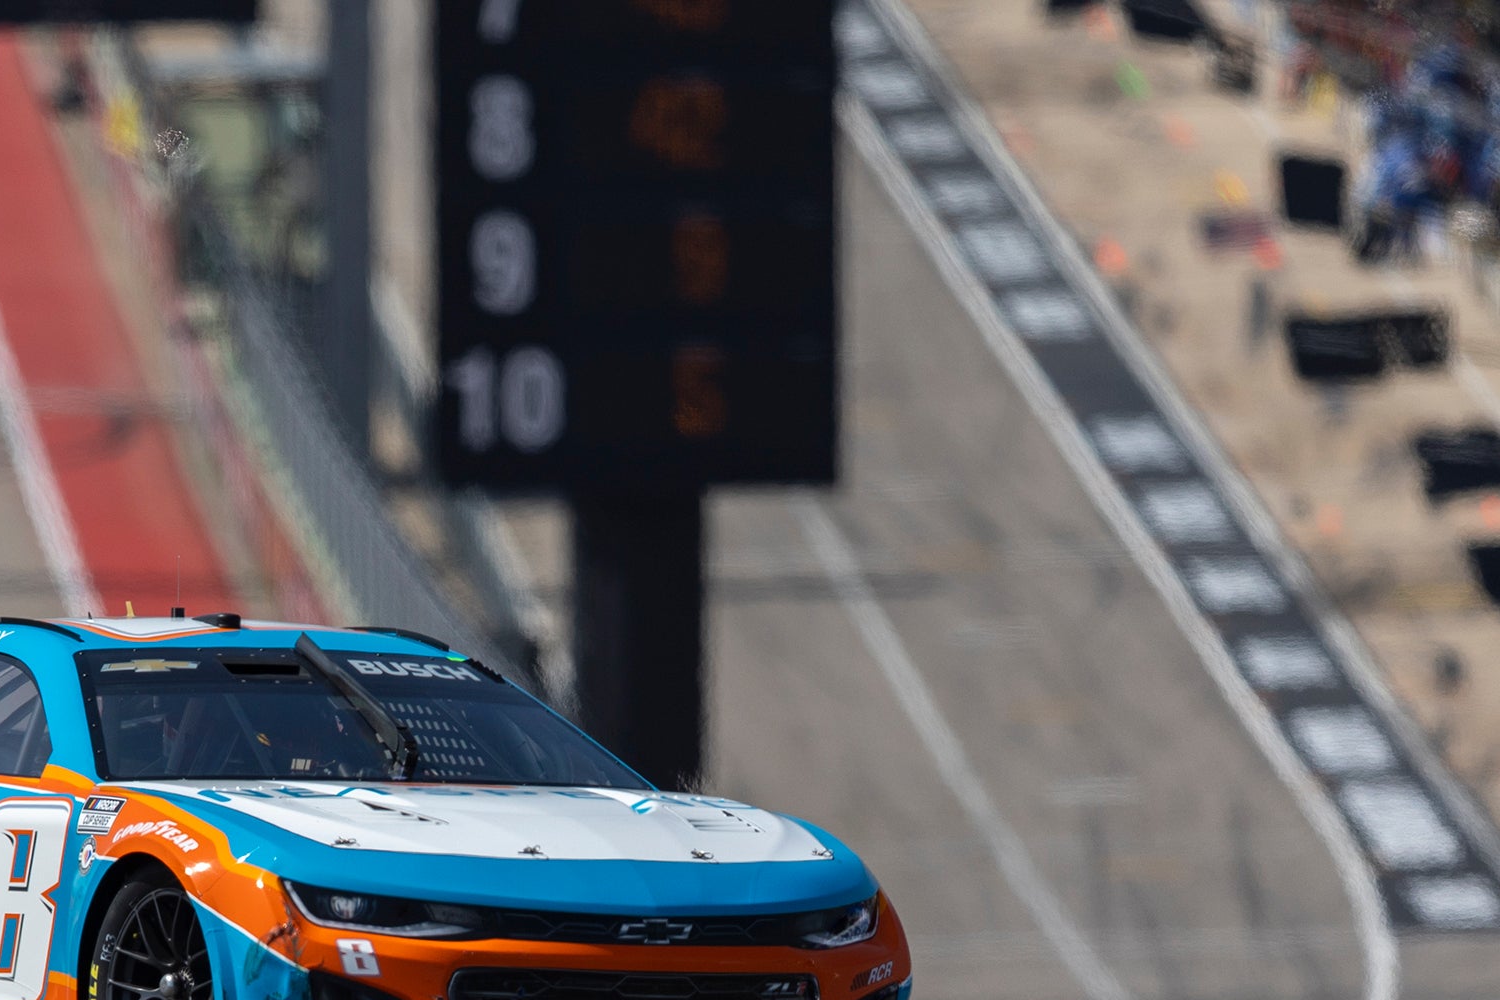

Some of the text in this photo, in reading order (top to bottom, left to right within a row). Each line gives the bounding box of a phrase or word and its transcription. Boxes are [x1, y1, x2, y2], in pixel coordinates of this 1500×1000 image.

[467, 72, 535, 183] 8
[468, 208, 535, 315] 9
[444, 345, 566, 453] 10
[347, 659, 482, 682] BUSCH
[112, 820, 199, 853] GOODYEAR
[336, 938, 381, 977] 8
[868, 961, 894, 985] RCR
